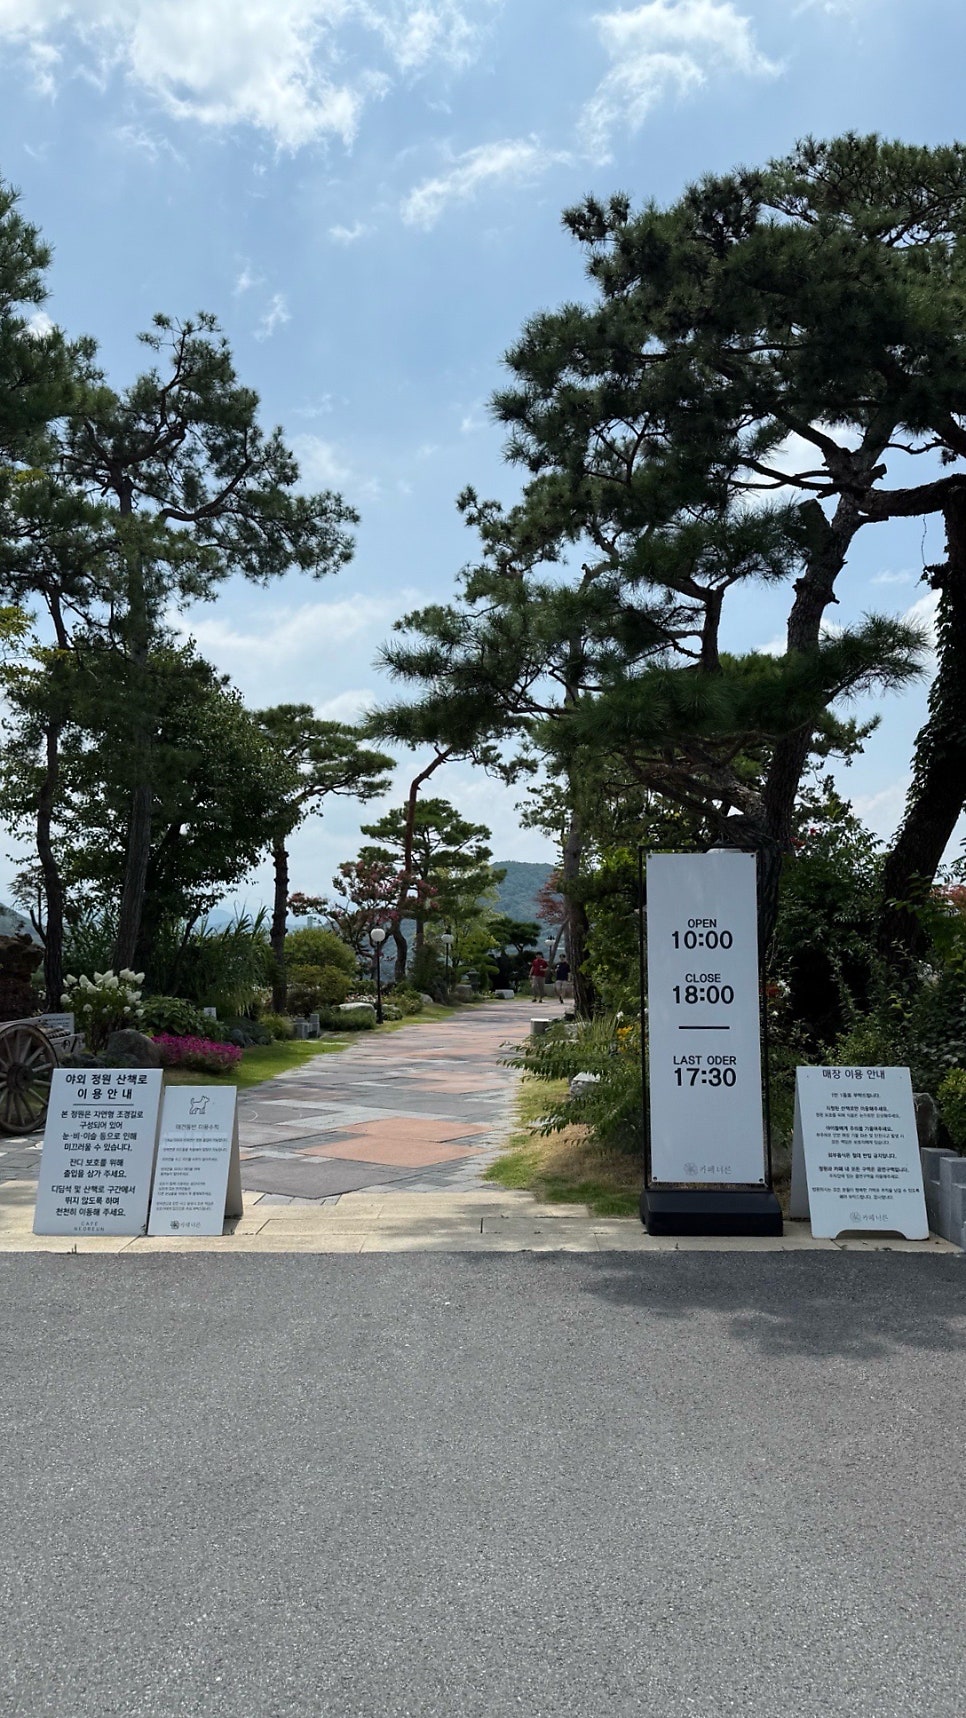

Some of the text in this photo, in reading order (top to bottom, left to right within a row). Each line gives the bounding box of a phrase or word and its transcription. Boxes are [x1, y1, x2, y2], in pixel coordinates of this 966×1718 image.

[687, 919, 717, 928] OPEN
[671, 930, 733, 949] 10:00
[685, 973, 721, 983] CLOSE
[672, 985, 734, 1004] 18:00
[673, 1056, 737, 1065] LAST ODER
[674, 1068, 737, 1087] 17:30
[822, 1069, 885, 1079] 매장 이용 안내
[65, 1074, 148, 1085] 야외 정원 산책로
[61, 1110, 143, 1118] 본 정원은 자연형 조경길로
[80, 1121, 123, 1129] 구성되어 있어
[100, 1132, 121, 1140] 등으로
[123, 1132, 137, 1140] 인해
[64, 1143, 133, 1151] 미끄러울 수 있습니다.
[70, 1159, 124, 1167] 잔디 보호를 위해
[63, 1170, 127, 1178] 출입을 삼가 주세요.
[51, 1185, 136, 1194] 디딤석 및 산책로 구간에서
[65, 1197, 120, 1205] 뛰지 않도록 하며
[56, 1208, 126, 1216] 천천히 이동해 주세요.
